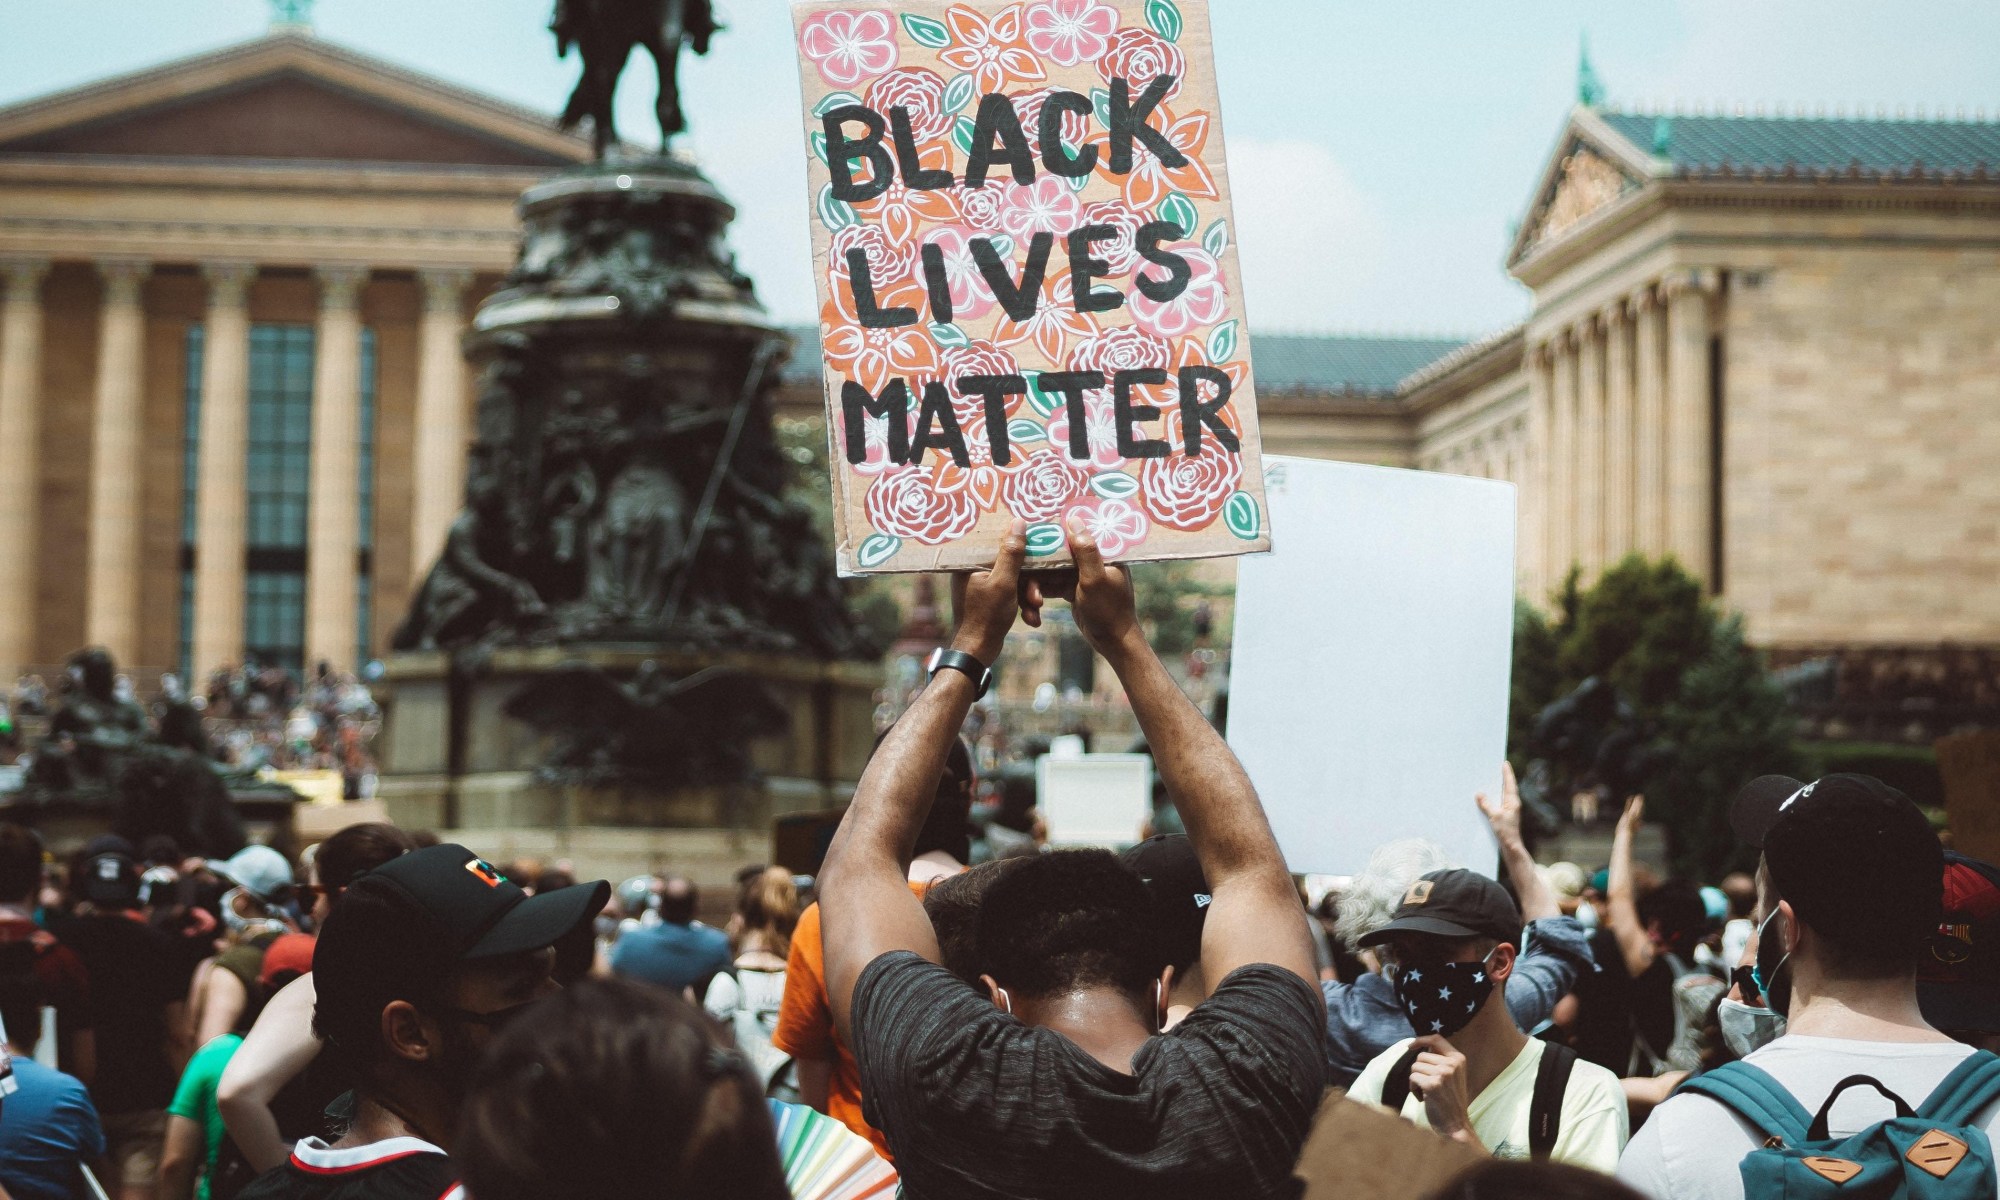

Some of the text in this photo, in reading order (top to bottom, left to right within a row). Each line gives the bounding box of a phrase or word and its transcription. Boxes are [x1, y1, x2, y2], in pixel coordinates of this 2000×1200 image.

[822, 74, 1188, 202] BLACK
[846, 221, 1193, 328] LIVES
[842, 366, 1241, 468] MATTER
